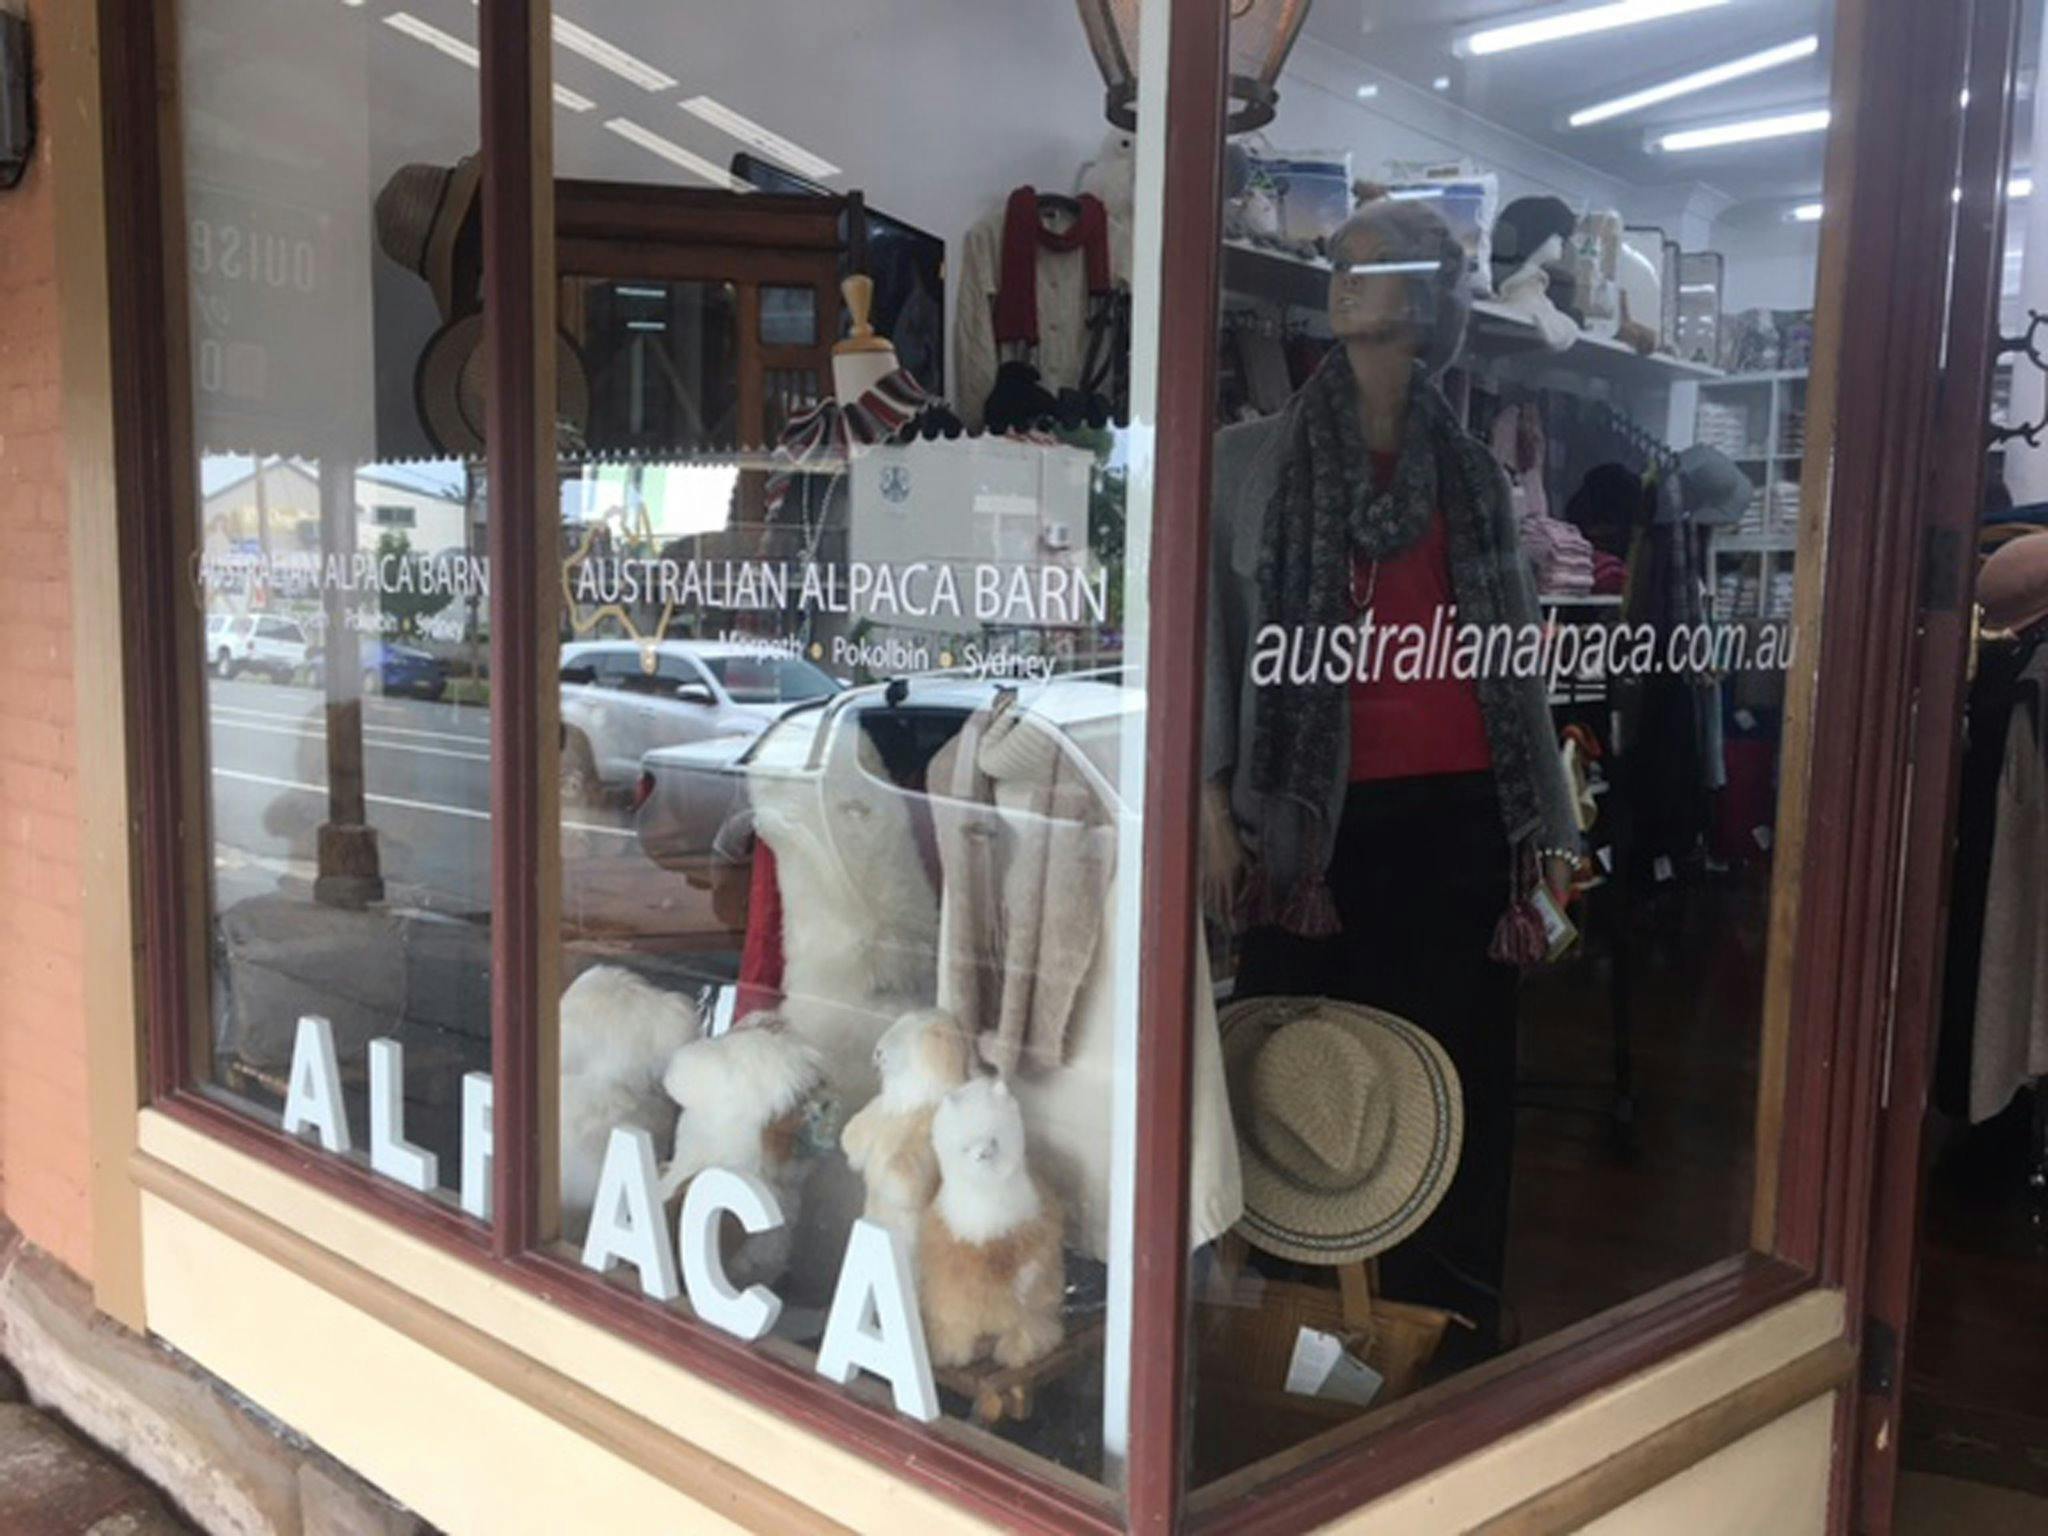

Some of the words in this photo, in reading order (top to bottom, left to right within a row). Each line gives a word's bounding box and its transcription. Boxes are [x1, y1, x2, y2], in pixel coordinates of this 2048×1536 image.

[324, 552, 414, 595] ALPACA
[418, 554, 491, 598] BARN
[576, 557, 789, 610] AUSTRALIAN
[798, 560, 961, 619] ALPACA
[974, 563, 1108, 624] BARN
[831, 634, 930, 671] Pokolbin
[963, 643, 1057, 682] Sydney
[1250, 604, 1799, 693] australianalpaca.com.au
